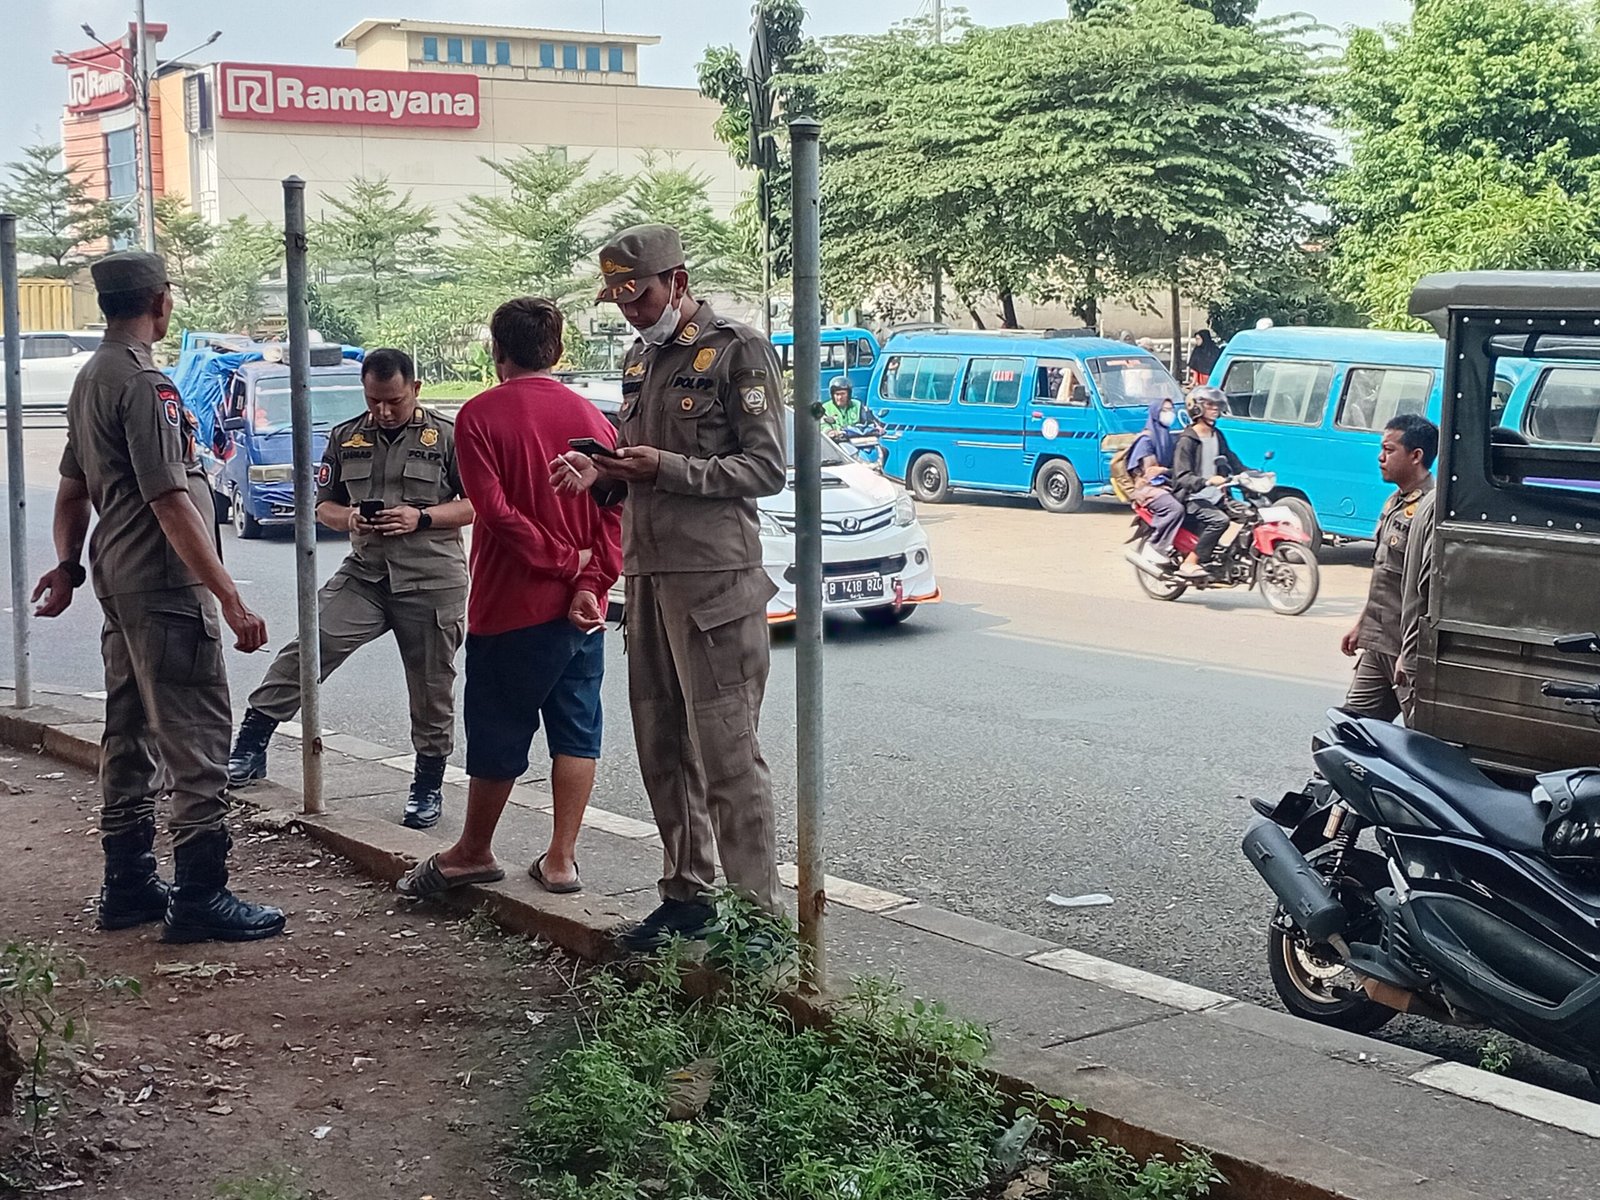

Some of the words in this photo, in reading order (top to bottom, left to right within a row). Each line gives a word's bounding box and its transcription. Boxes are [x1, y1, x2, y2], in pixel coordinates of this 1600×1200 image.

[276, 77, 475, 119] Ramayana
[408, 450, 426, 460] POL
[829, 582, 836, 595] B
[842, 580, 862, 593] 1418
